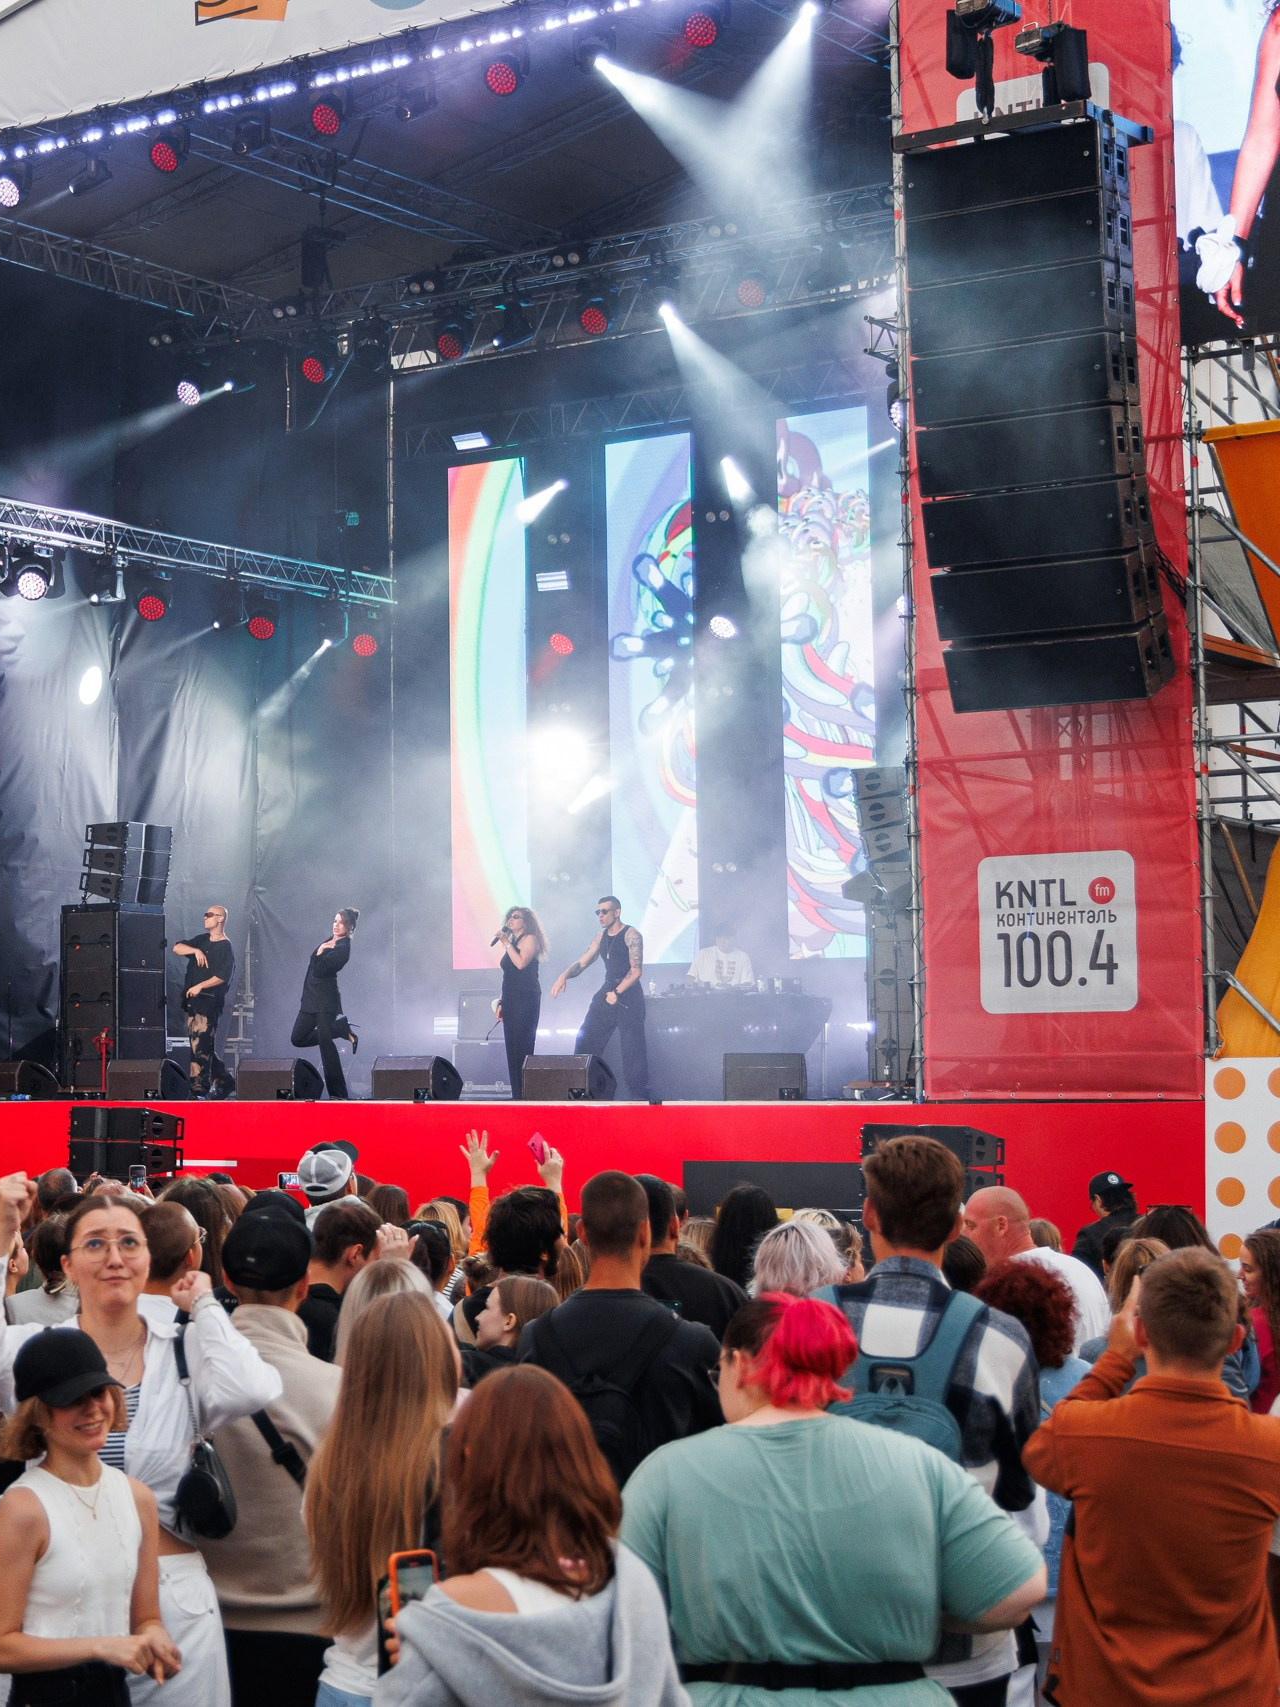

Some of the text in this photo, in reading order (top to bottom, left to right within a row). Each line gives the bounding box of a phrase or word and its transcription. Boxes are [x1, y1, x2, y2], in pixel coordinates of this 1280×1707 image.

[995, 878, 1110, 909] KNTL fm
[996, 909, 1117, 927] континенталь
[996, 929, 1119, 988] 100.4
